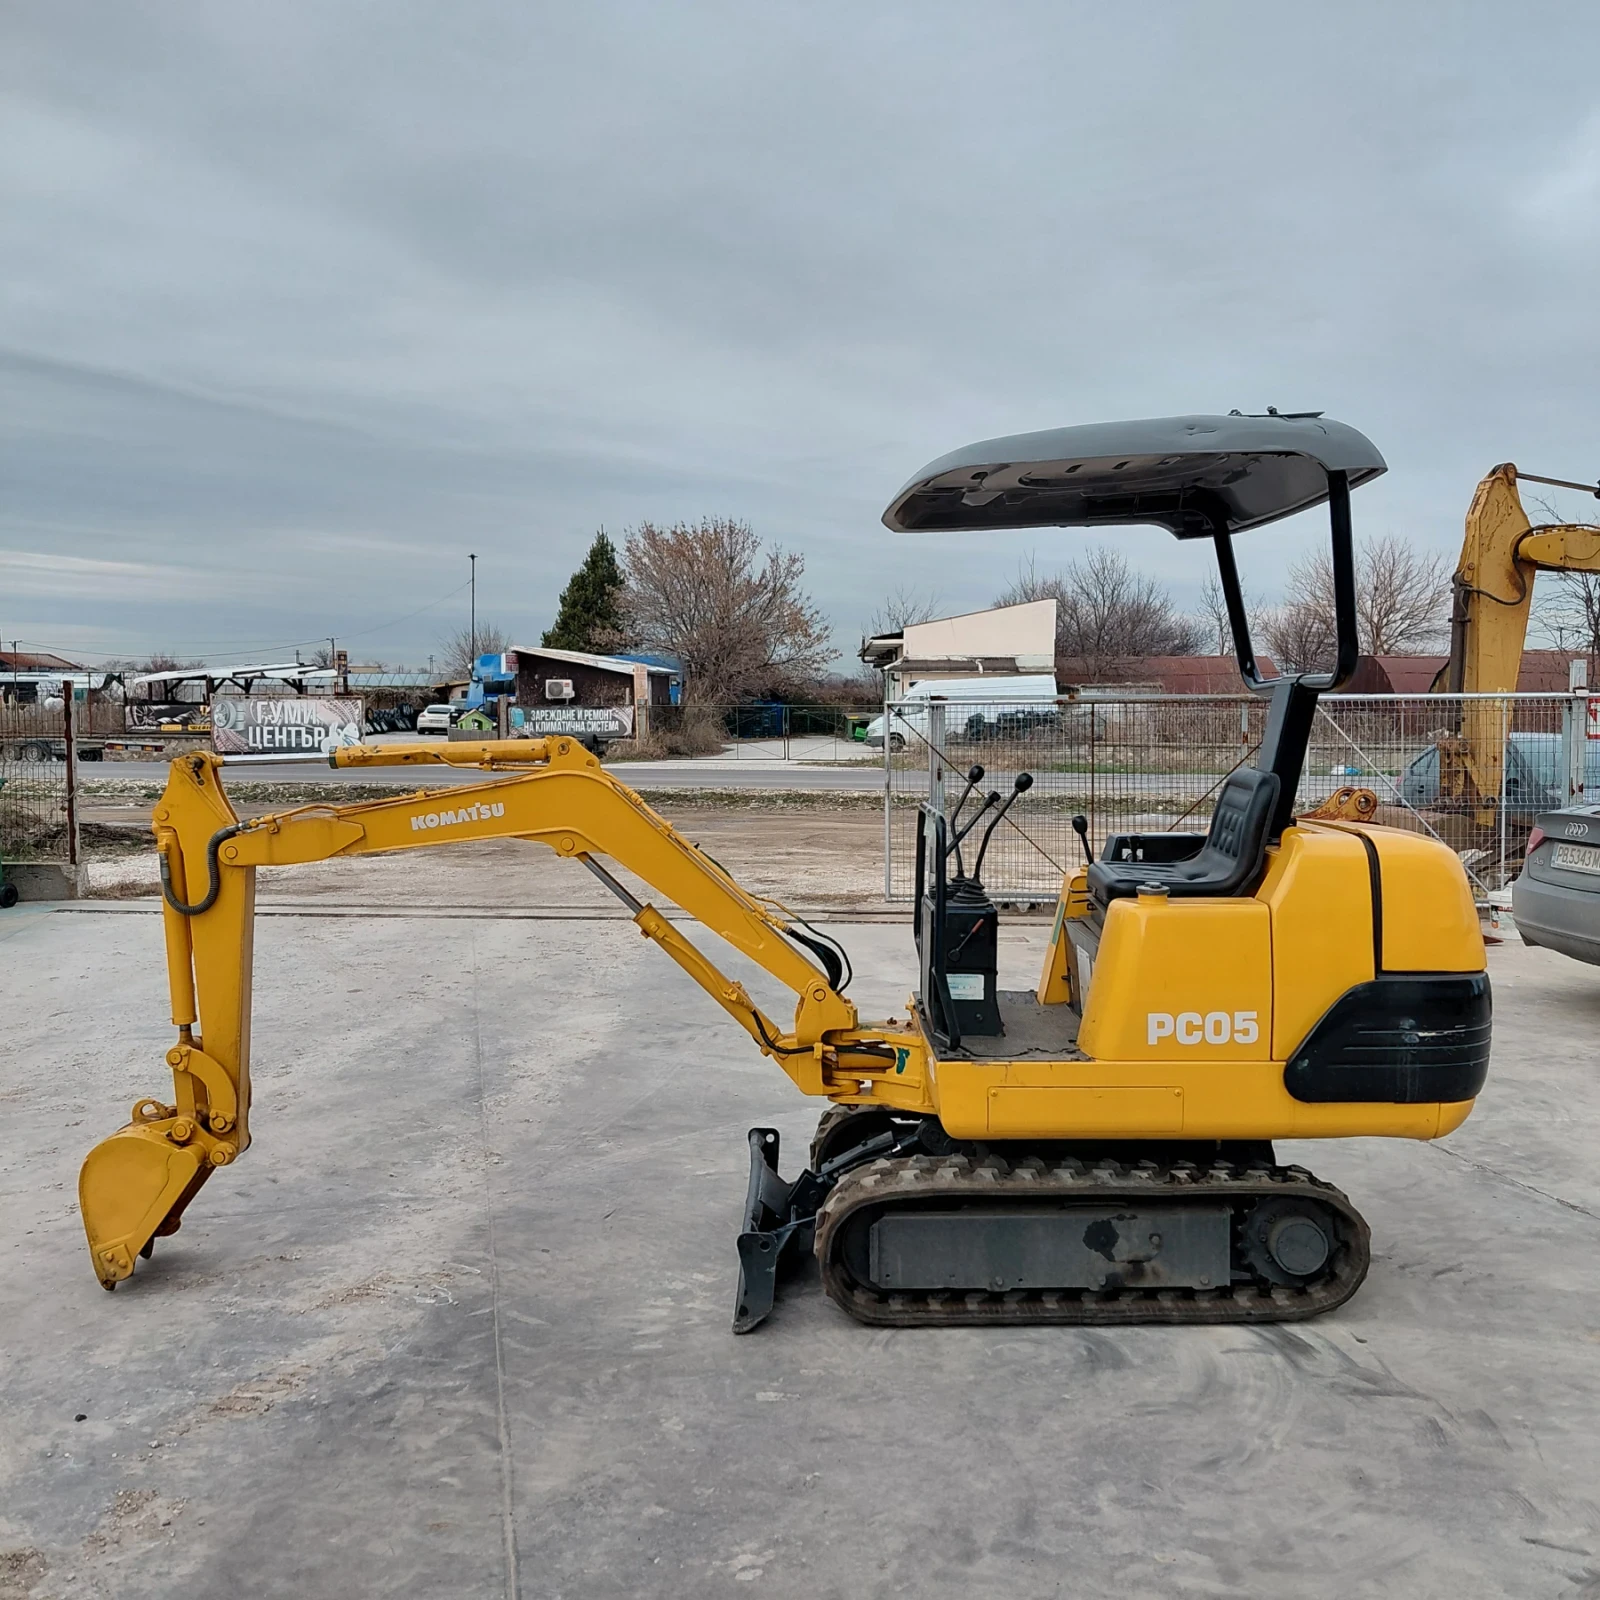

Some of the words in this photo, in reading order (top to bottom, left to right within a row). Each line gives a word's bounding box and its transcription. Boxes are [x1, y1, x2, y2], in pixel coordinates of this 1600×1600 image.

[256, 701, 317, 725] ГУМИ
[530, 709, 576, 721] ЗАРЕЖДАНЕ
[577, 709, 583, 720] И
[584, 709, 612, 720] РЕМОНТ
[248, 726, 325, 749] ЦЕНТЪР
[523, 721, 534, 732] НА
[535, 721, 586, 732] КЛИМАТИЧНА
[586, 720, 619, 731] СИСТЕМА
[410, 802, 505, 831] KOMATSU
[1147, 1011, 1259, 1045] PC05
